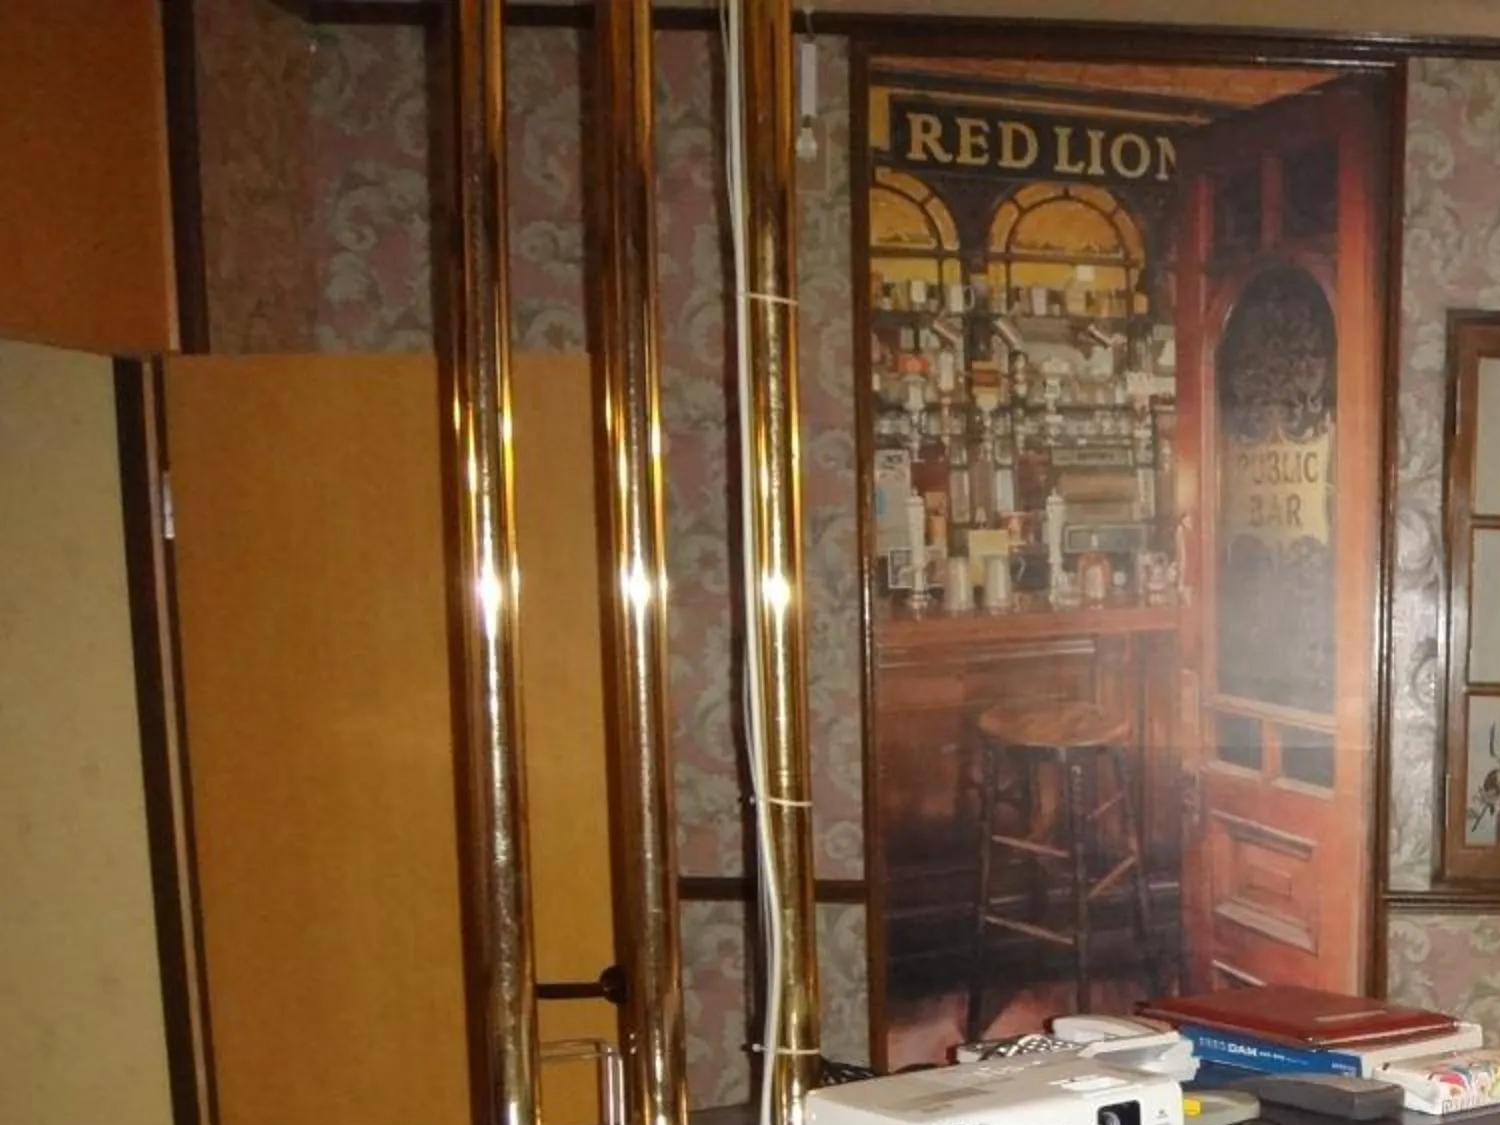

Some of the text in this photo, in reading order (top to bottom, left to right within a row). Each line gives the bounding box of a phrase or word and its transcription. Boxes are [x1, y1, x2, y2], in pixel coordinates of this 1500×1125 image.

[906, 112, 1038, 170] RED
[1239, 450, 1318, 484] PUBLIC
[1249, 494, 1303, 528] BAR
